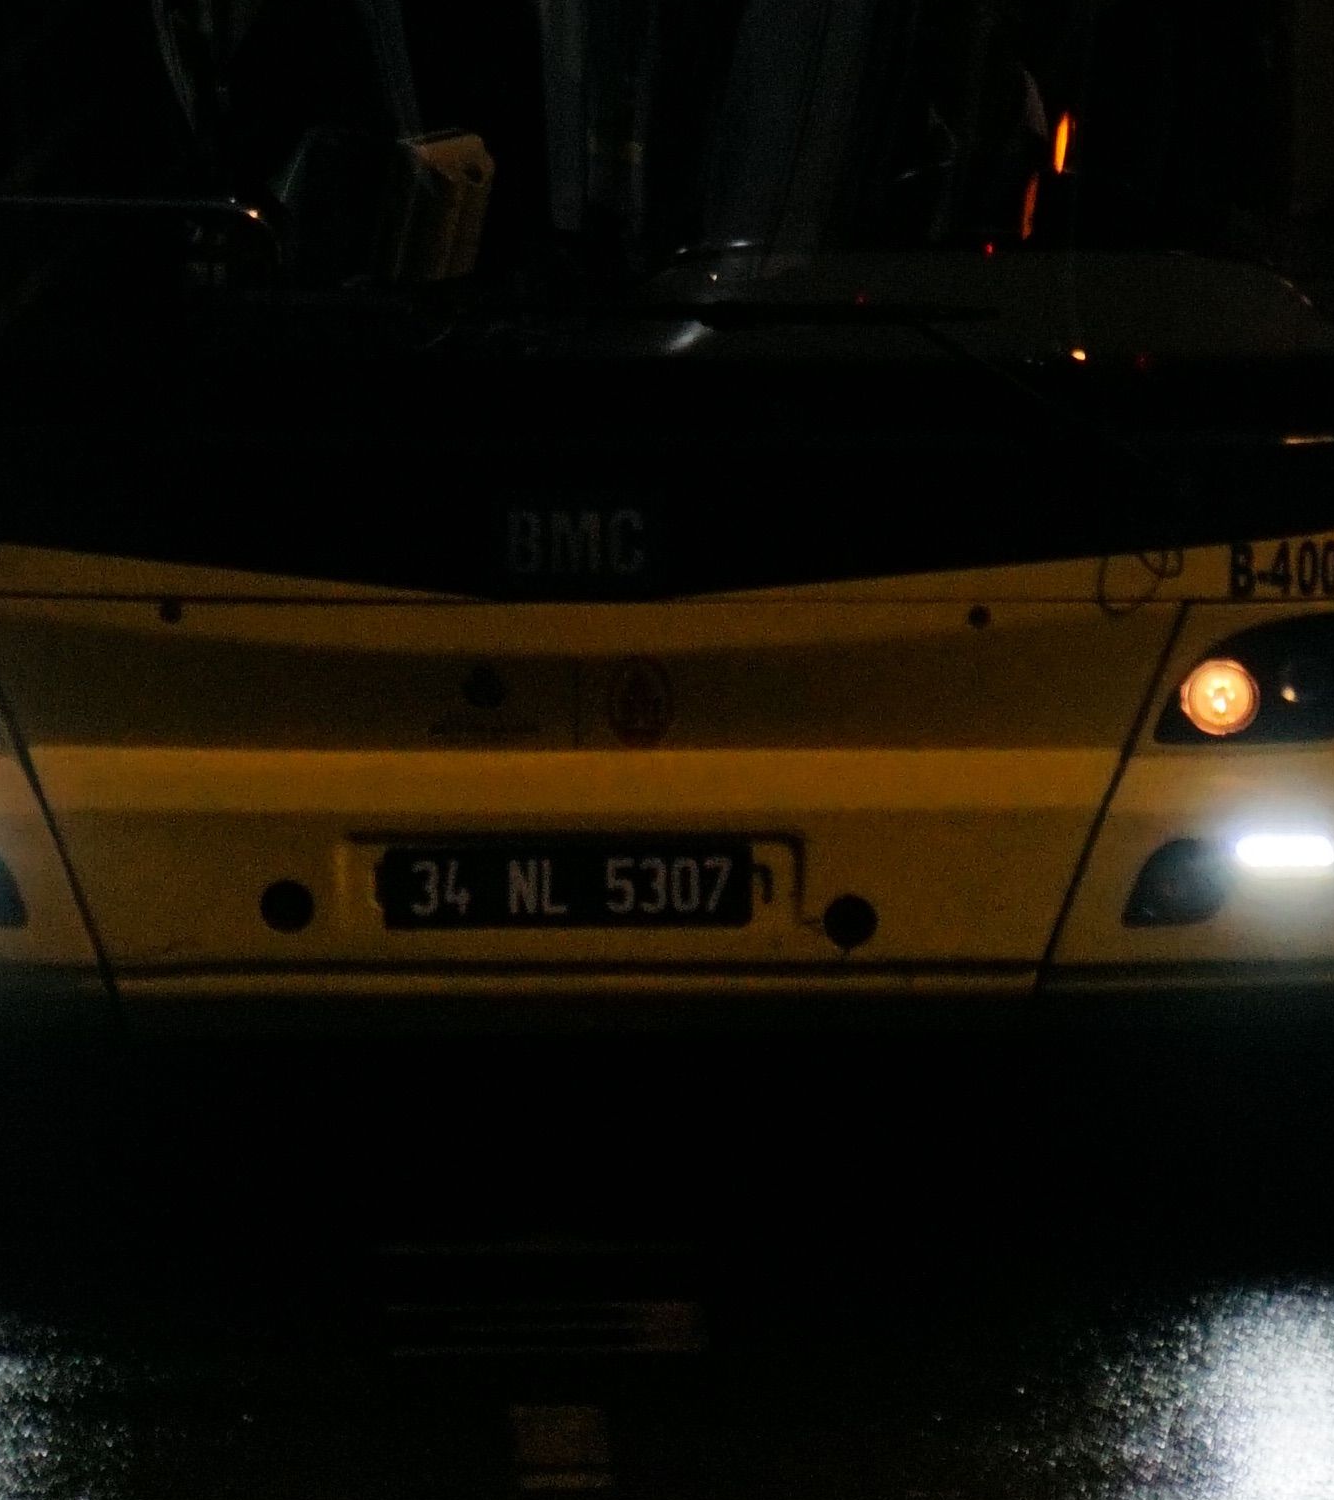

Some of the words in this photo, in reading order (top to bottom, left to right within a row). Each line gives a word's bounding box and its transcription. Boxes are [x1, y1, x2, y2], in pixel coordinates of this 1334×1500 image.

[506, 507, 645, 575] BMC
[410, 857, 473, 918] 34
[507, 856, 568, 916] NL
[603, 855, 733, 915] 5307
